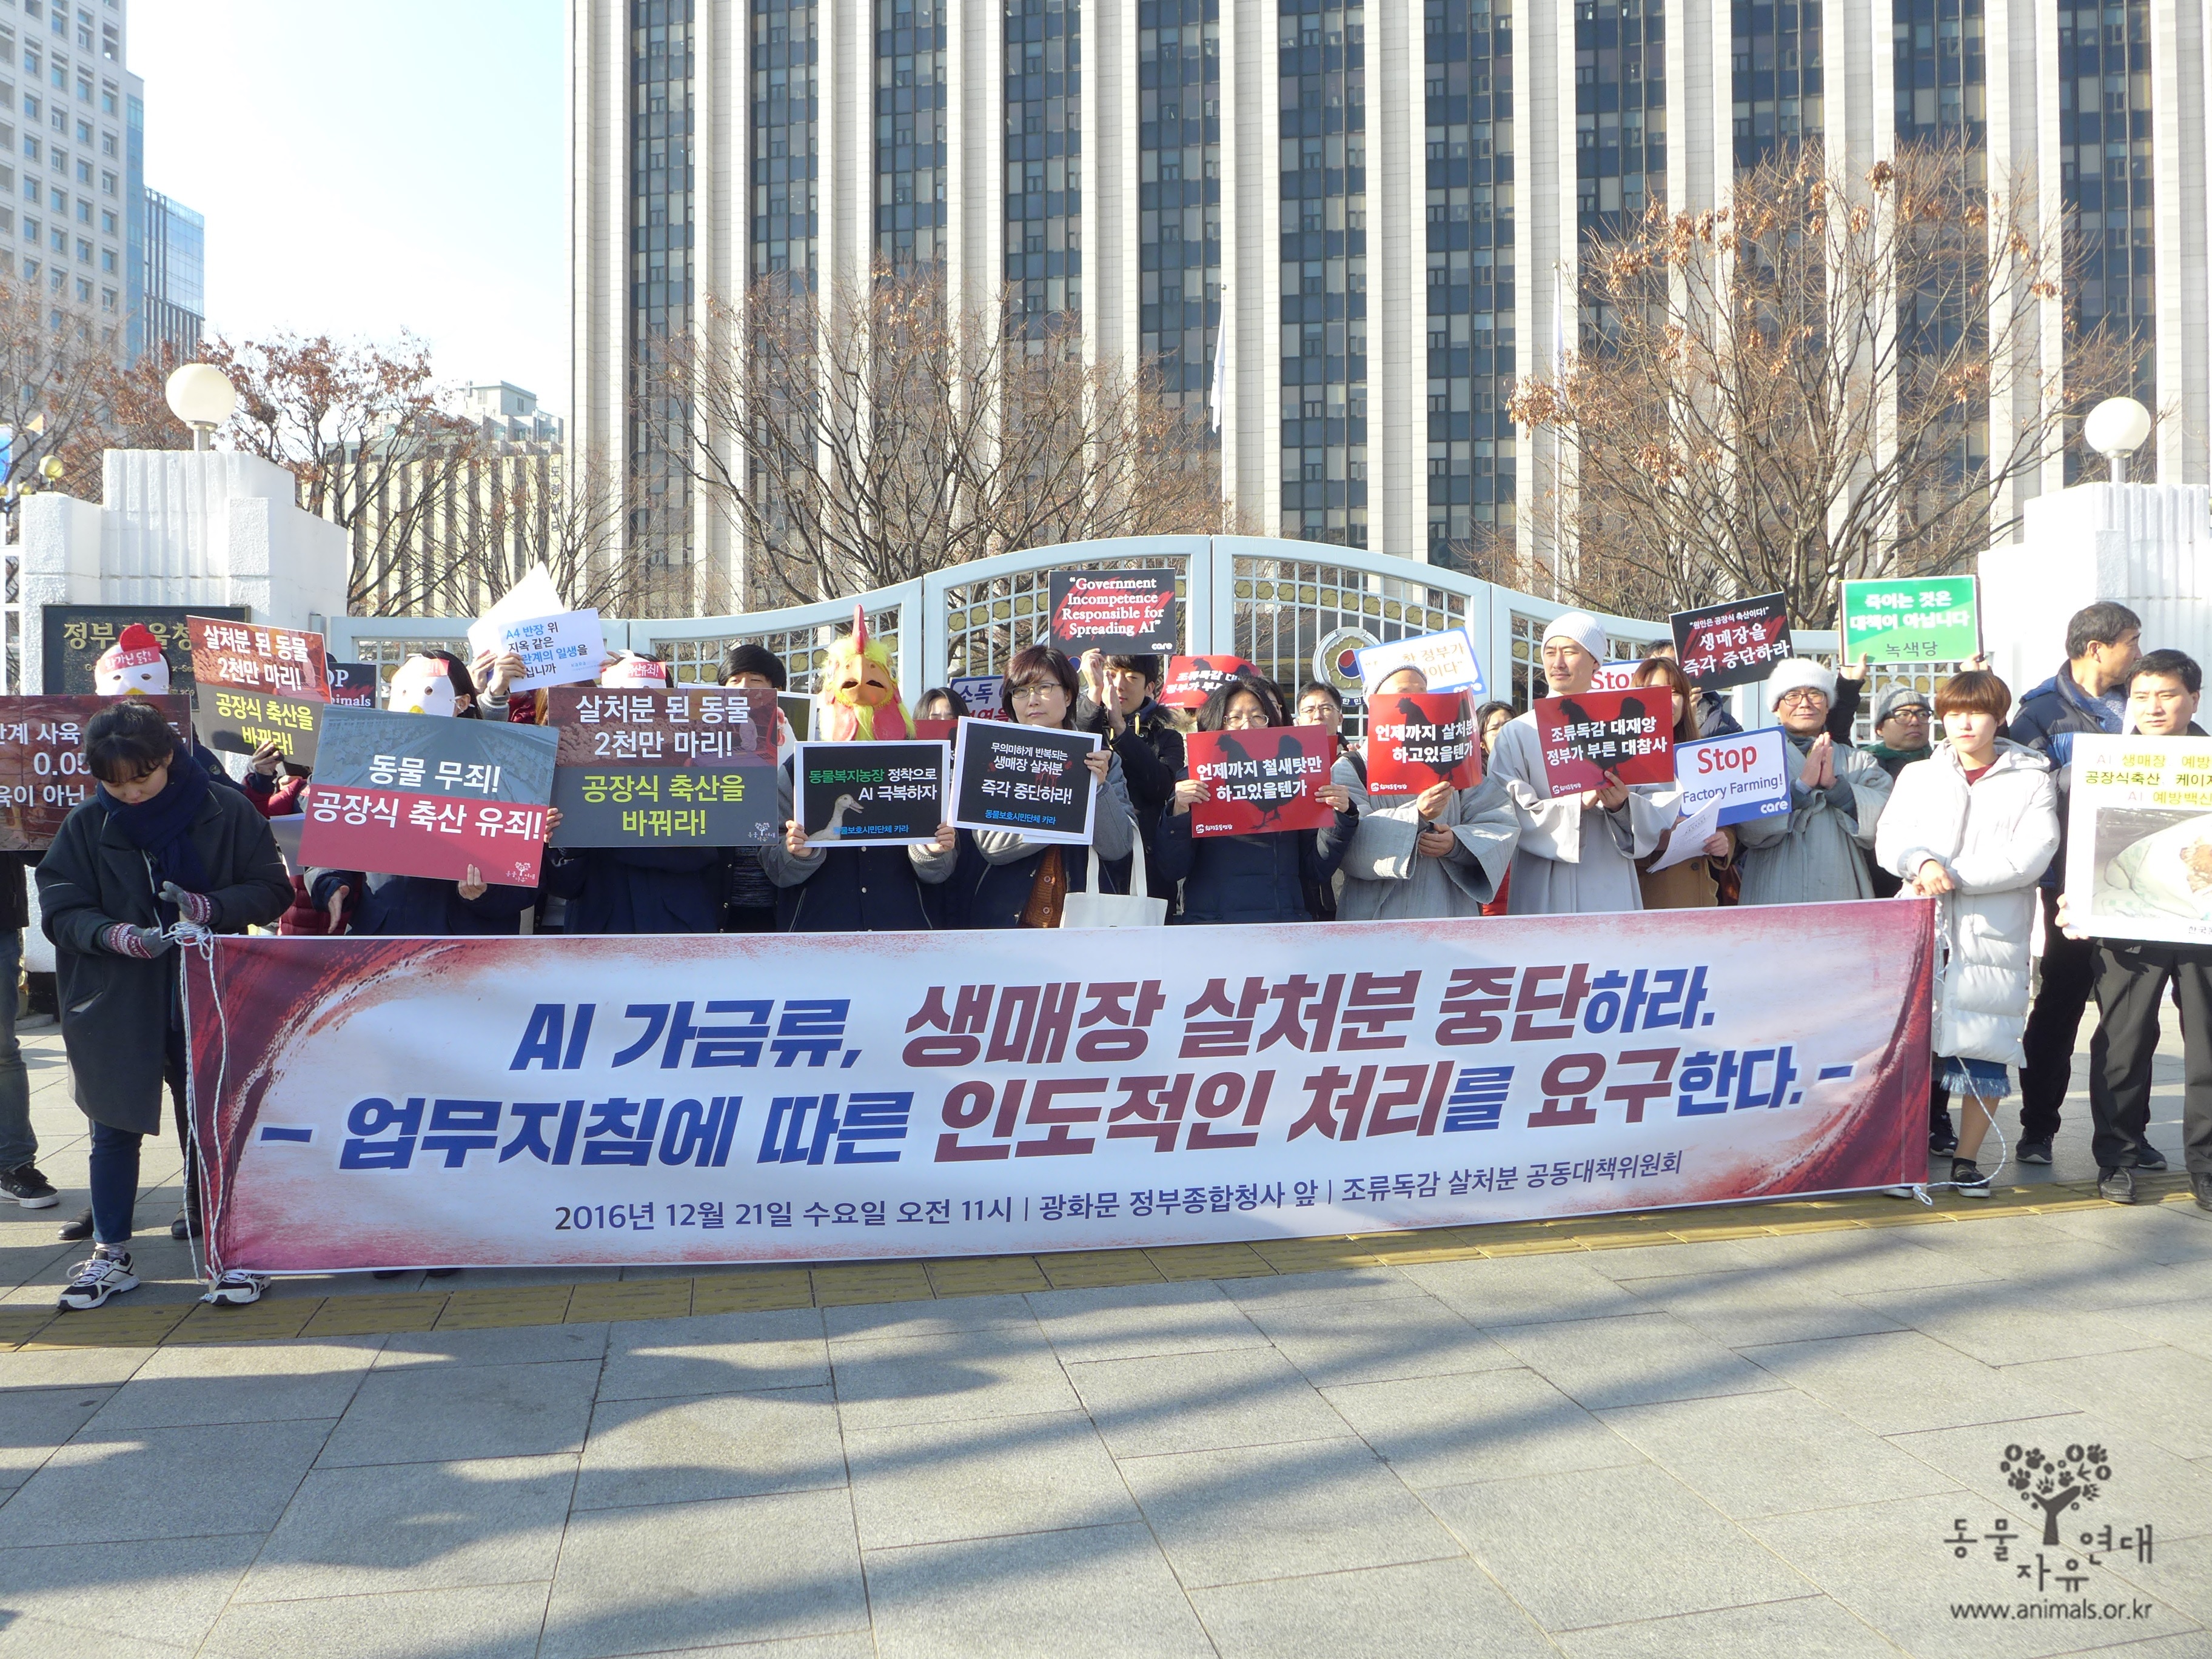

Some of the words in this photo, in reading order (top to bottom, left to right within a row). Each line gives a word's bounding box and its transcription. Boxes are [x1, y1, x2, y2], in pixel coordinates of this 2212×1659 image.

[1067, 593, 1158, 607] Incompetence
[1865, 592, 1914, 609] 죽이는
[1919, 591, 1952, 608] 것은
[1062, 606, 1140, 622] Responsible
[1144, 607, 1164, 618] for
[1714, 614, 1734, 625] 공장식
[1850, 613, 1899, 631] 대책이
[1903, 610, 1970, 628] 아닙니다
[506, 629, 521, 640] A4
[523, 624, 544, 637] 반장
[548, 622, 558, 634] 위
[1069, 622, 1134, 638] Spreading
[1699, 623, 1766, 651] 생매장을
[203, 625, 250, 654] 살처분
[255, 631, 272, 657] 된
[275, 635, 308, 662] 동물
[508, 640, 529, 653] 지옥
[532, 636, 554, 650] 같은
[1421, 643, 1464, 662] 정부가
[1886, 641, 1939, 657] 녹색당
[521, 649, 553, 665] 란계의
[556, 644, 588, 660] 일생을
[1683, 655, 1717, 676] 즉각
[1721, 640, 1790, 669] 중단하라
[218, 657, 260, 685] 2천만
[264, 665, 302, 691] 마리!
[526, 663, 556, 678] 십니까
[1591, 671, 1633, 689] Sto
[332, 694, 371, 706] imals
[575, 695, 655, 723] 살처분
[666, 695, 689, 723] 된
[699, 696, 751, 724] 동물
[215, 692, 262, 723] 공장식
[266, 700, 313, 731] 축산을
[36, 722, 81, 745] 사육
[1375, 724, 1436, 742] 언제까지
[1551, 720, 1606, 742] 조류독감
[1610, 716, 1657, 735] 대재앙
[594, 731, 665, 759] 2천만
[674, 731, 732, 759] 마리!
[991, 742, 1033, 757] 무의미하게
[1035, 748, 1068, 762] 반복되는
[1392, 740, 1473, 763] 하고있을텐가
[1546, 746, 1583, 766] 정부가
[1587, 741, 1617, 759] 부른
[1621, 736, 1667, 756] 대참사
[993, 755, 1028, 772] 생매장
[1030, 762, 1064, 776] 살처분
[1196, 760, 1259, 782] 언제까지
[1262, 756, 1322, 777] 철새탓만
[1697, 745, 1757, 774] Stop
[2097, 755, 2111, 764] AI
[369, 754, 426, 788] 동물
[434, 761, 501, 794] 무죄!
[809, 768, 885, 784] 동물복지농장
[888, 768, 937, 782] 정착으로
[42, 785, 84, 806] 아닌
[581, 775, 659, 803] 공장식
[668, 775, 745, 802] 축산을
[858, 787, 873, 801] AI
[877, 784, 937, 801] 극복하자
[981, 779, 1011, 798] 즉각
[1013, 782, 1072, 805] 중단하라!
[1216, 779, 1307, 802] 하고있을텐가
[1683, 787, 1727, 803] Factory
[1730, 773, 1783, 794] Farming!
[2128, 792, 2142, 801] AI
[312, 791, 400, 828] 공장식
[408, 800, 468, 834] 축산
[475, 806, 542, 840] 유죄!
[985, 809, 1041, 824] 동물보호시민단체
[1042, 816, 1056, 825] 카라
[1760, 800, 1788, 814] care
[622, 809, 706, 837] 바꿔라!
[833, 825, 892, 835] 동물보호시민단체
[894, 825, 910, 834] 카라
[509, 1003, 594, 1071] AI
[611, 998, 863, 1069] 가금류,
[902, 979, 1167, 1068] 생매장
[1178, 967, 1426, 1058] 살처분
[1434, 963, 1715, 1047] 중단하라.
[338, 1095, 744, 1170] 업무지침에
[756, 1091, 916, 1165] 따른
[933, 1068, 1276, 1164] 인도적인
[1285, 1059, 1515, 1142] 처리를
[1527, 1045, 1801, 1128] 요구한다.
[554, 1202, 655, 1232] 2016년
[665, 1201, 725, 1229] 12월
[734, 1201, 793, 1228] 21일
[802, 1201, 886, 1228] 수요일
[896, 1199, 951, 1226] 오전
[961, 1196, 1013, 1223] 11시
[1039, 1191, 1121, 1221] 광화문
[1129, 1181, 1286, 1218] 정부종합청사
[1293, 1179, 1318, 1208] 앞
[1341, 1171, 1441, 1202] 조류독감
[1448, 1166, 1519, 1195] 살처분
[1526, 1150, 1683, 1188] 공동대책위원회
